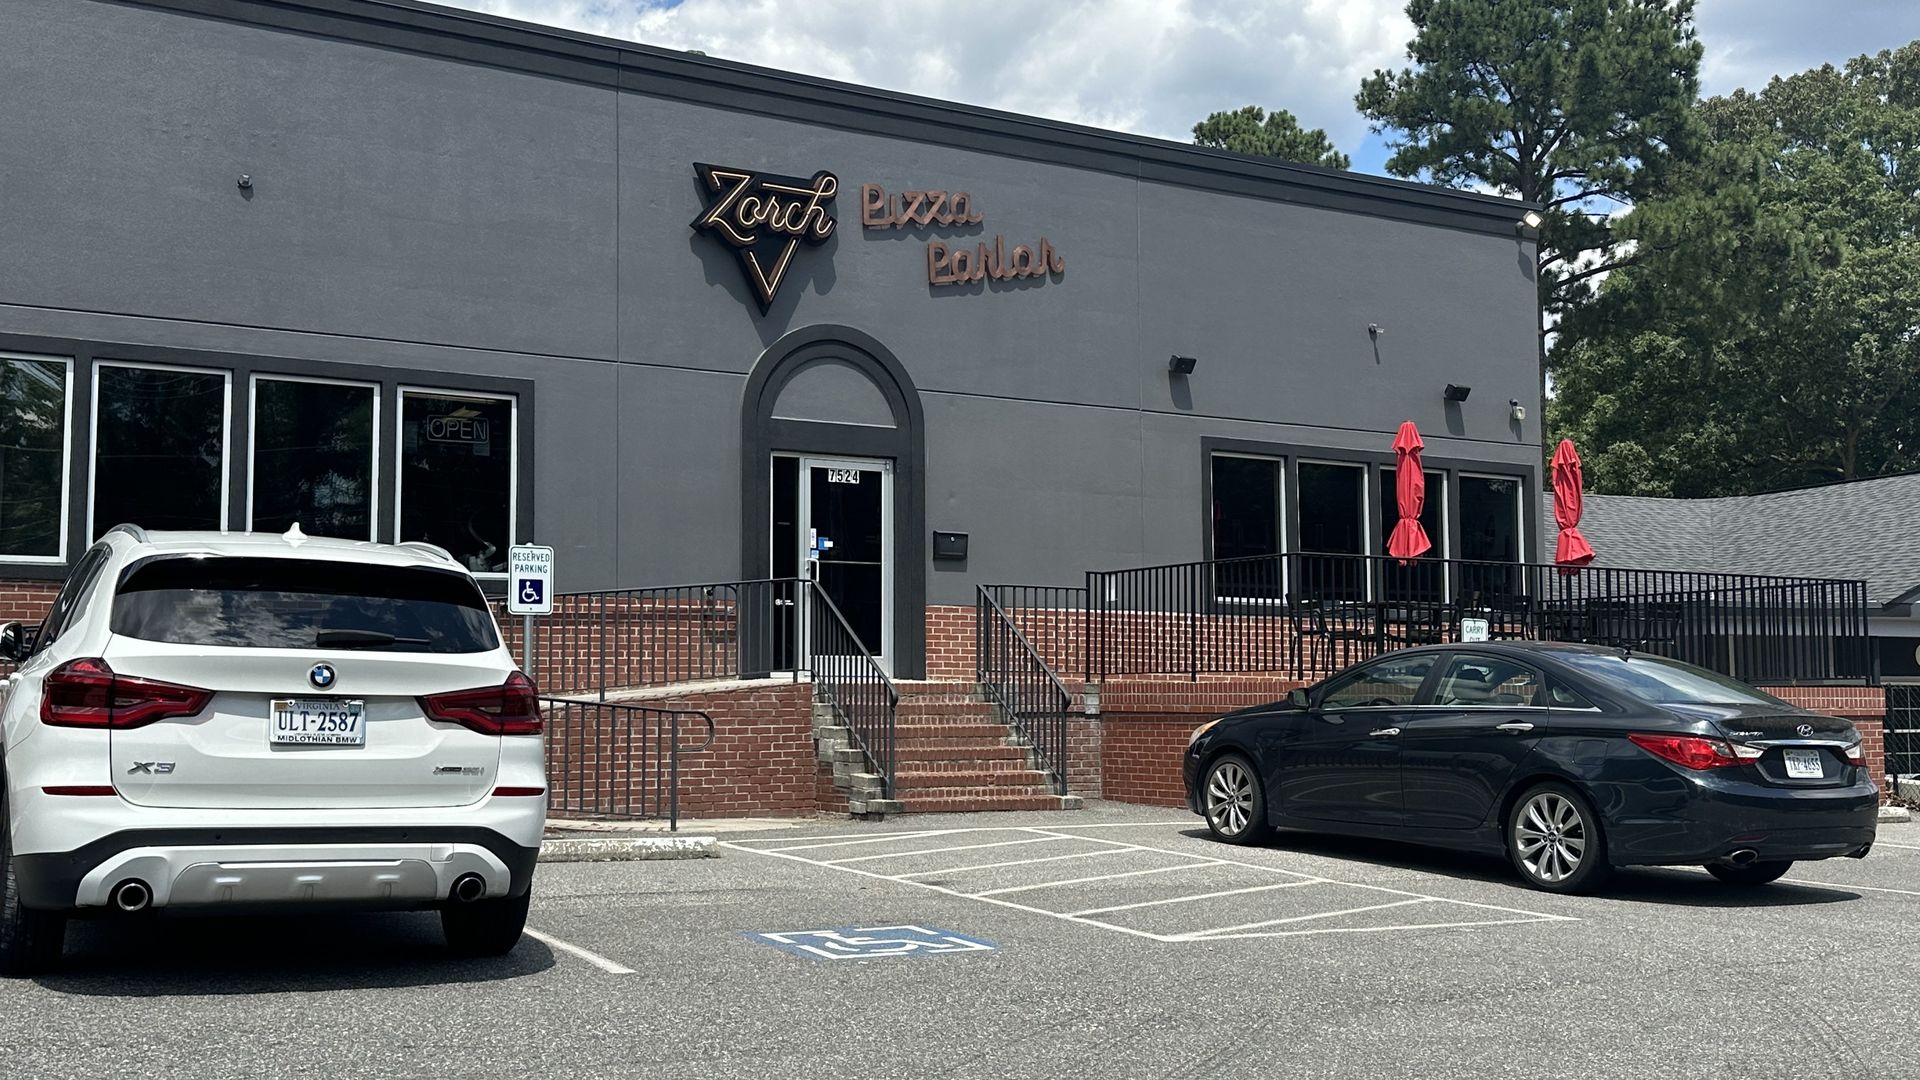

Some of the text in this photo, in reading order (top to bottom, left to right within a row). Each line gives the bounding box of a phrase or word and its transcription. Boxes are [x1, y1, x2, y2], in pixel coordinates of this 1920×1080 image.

[705, 169, 837, 244] Zorch
[862, 183, 983, 230] Pizza
[928, 234, 1064, 284] Parlor
[430, 418, 486, 440] OPEN
[829, 469, 859, 483] 7524
[512, 552, 550, 562] RESERVED
[514, 564, 548, 574] PARKING
[1465, 625, 1484, 634] CARRY
[295, 702, 340, 710] VIRGINIA
[277, 711, 359, 732] ULT-2587
[277, 735, 333, 743] MIDLOTHIAN
[127, 761, 176, 775] X3
